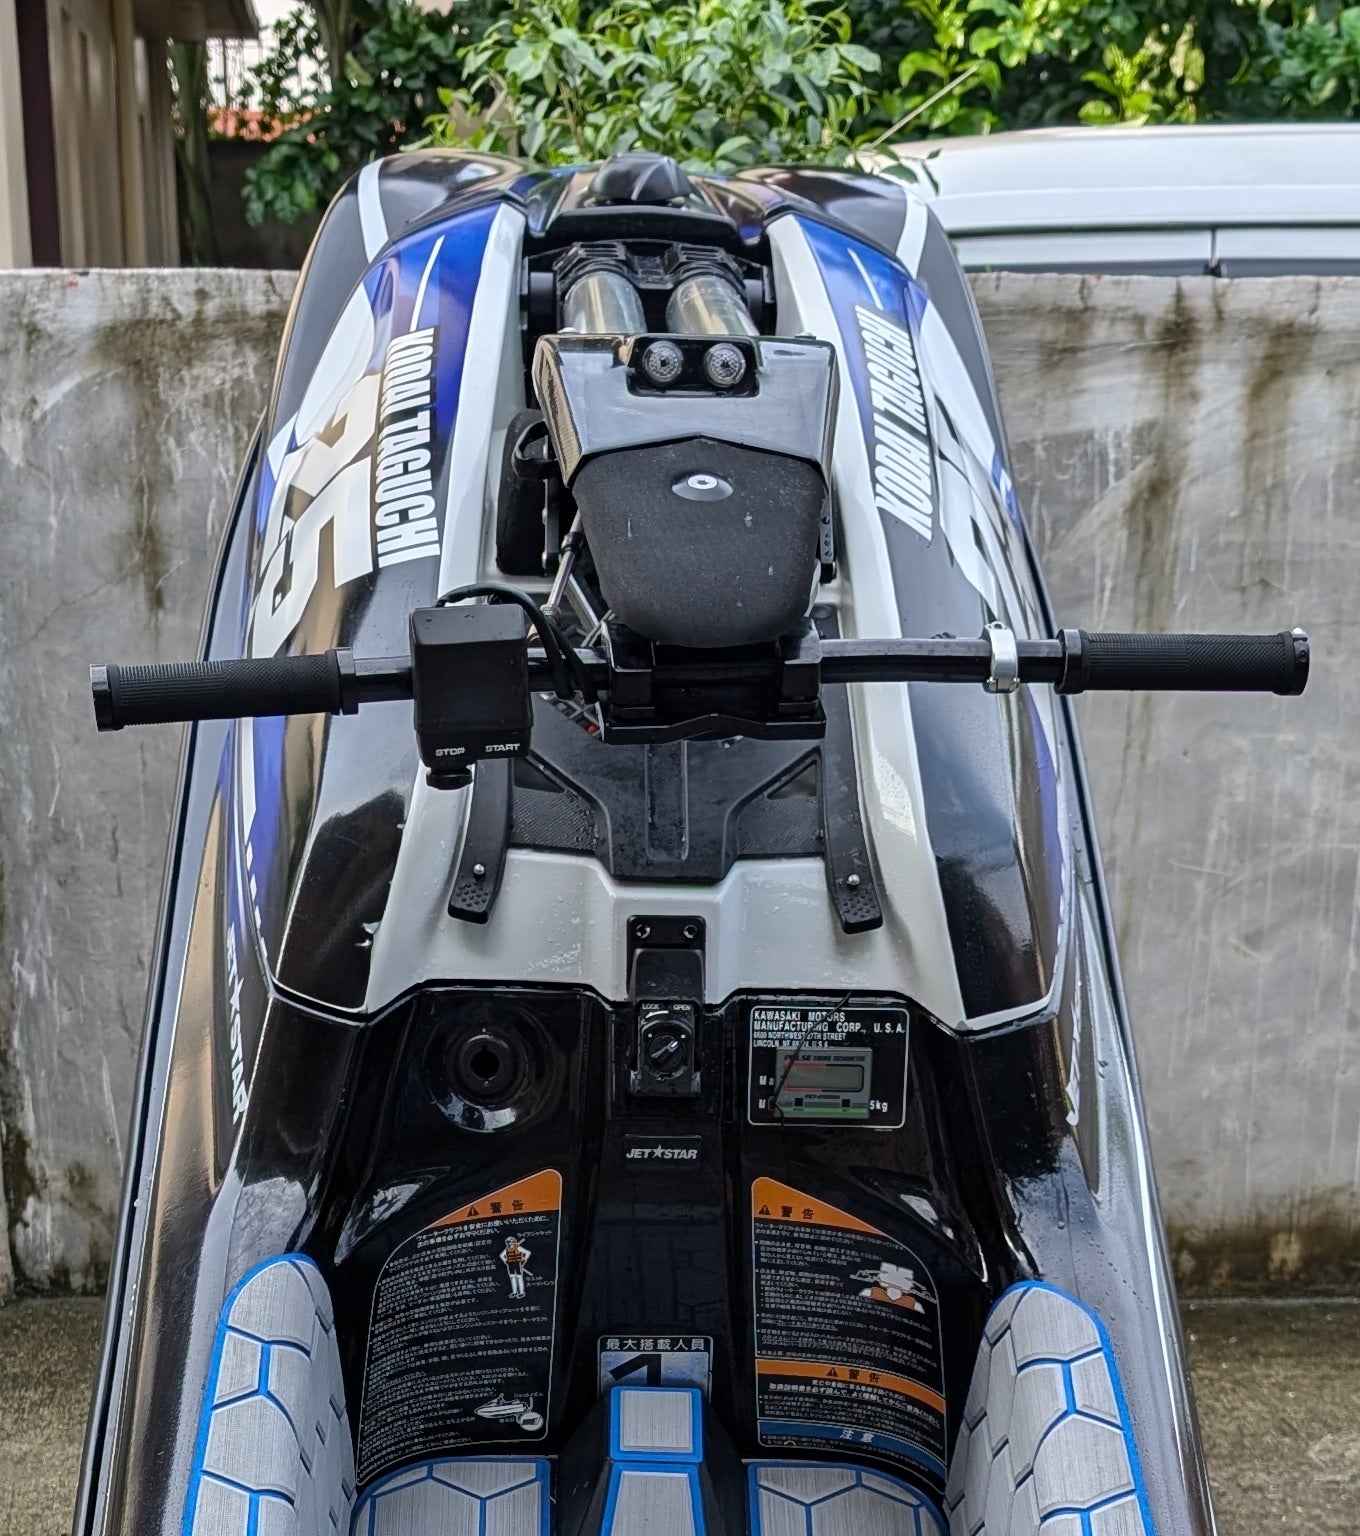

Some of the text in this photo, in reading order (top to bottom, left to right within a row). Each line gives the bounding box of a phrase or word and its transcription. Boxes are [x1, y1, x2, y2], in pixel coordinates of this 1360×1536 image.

[855, 305, 933, 541] KODAI TAGUCHI
[375, 328, 441, 569] KODAI TAGUCHI
[435, 743, 521, 757] STOP START
[673, 1003, 691, 1011] OPEN
[754, 1010, 801, 1021] KAWASAKI
[822, 1032, 847, 1041] STREET
[228, 1012, 250, 1126] STAR
[625, 1148, 698, 1160] JET STAR
[489, 1199, 525, 1214] 警告
[780, 1204, 815, 1220] 警告
[605, 1338, 705, 1351] 最大搭載人員
[838, 1427, 876, 1443] 注意
